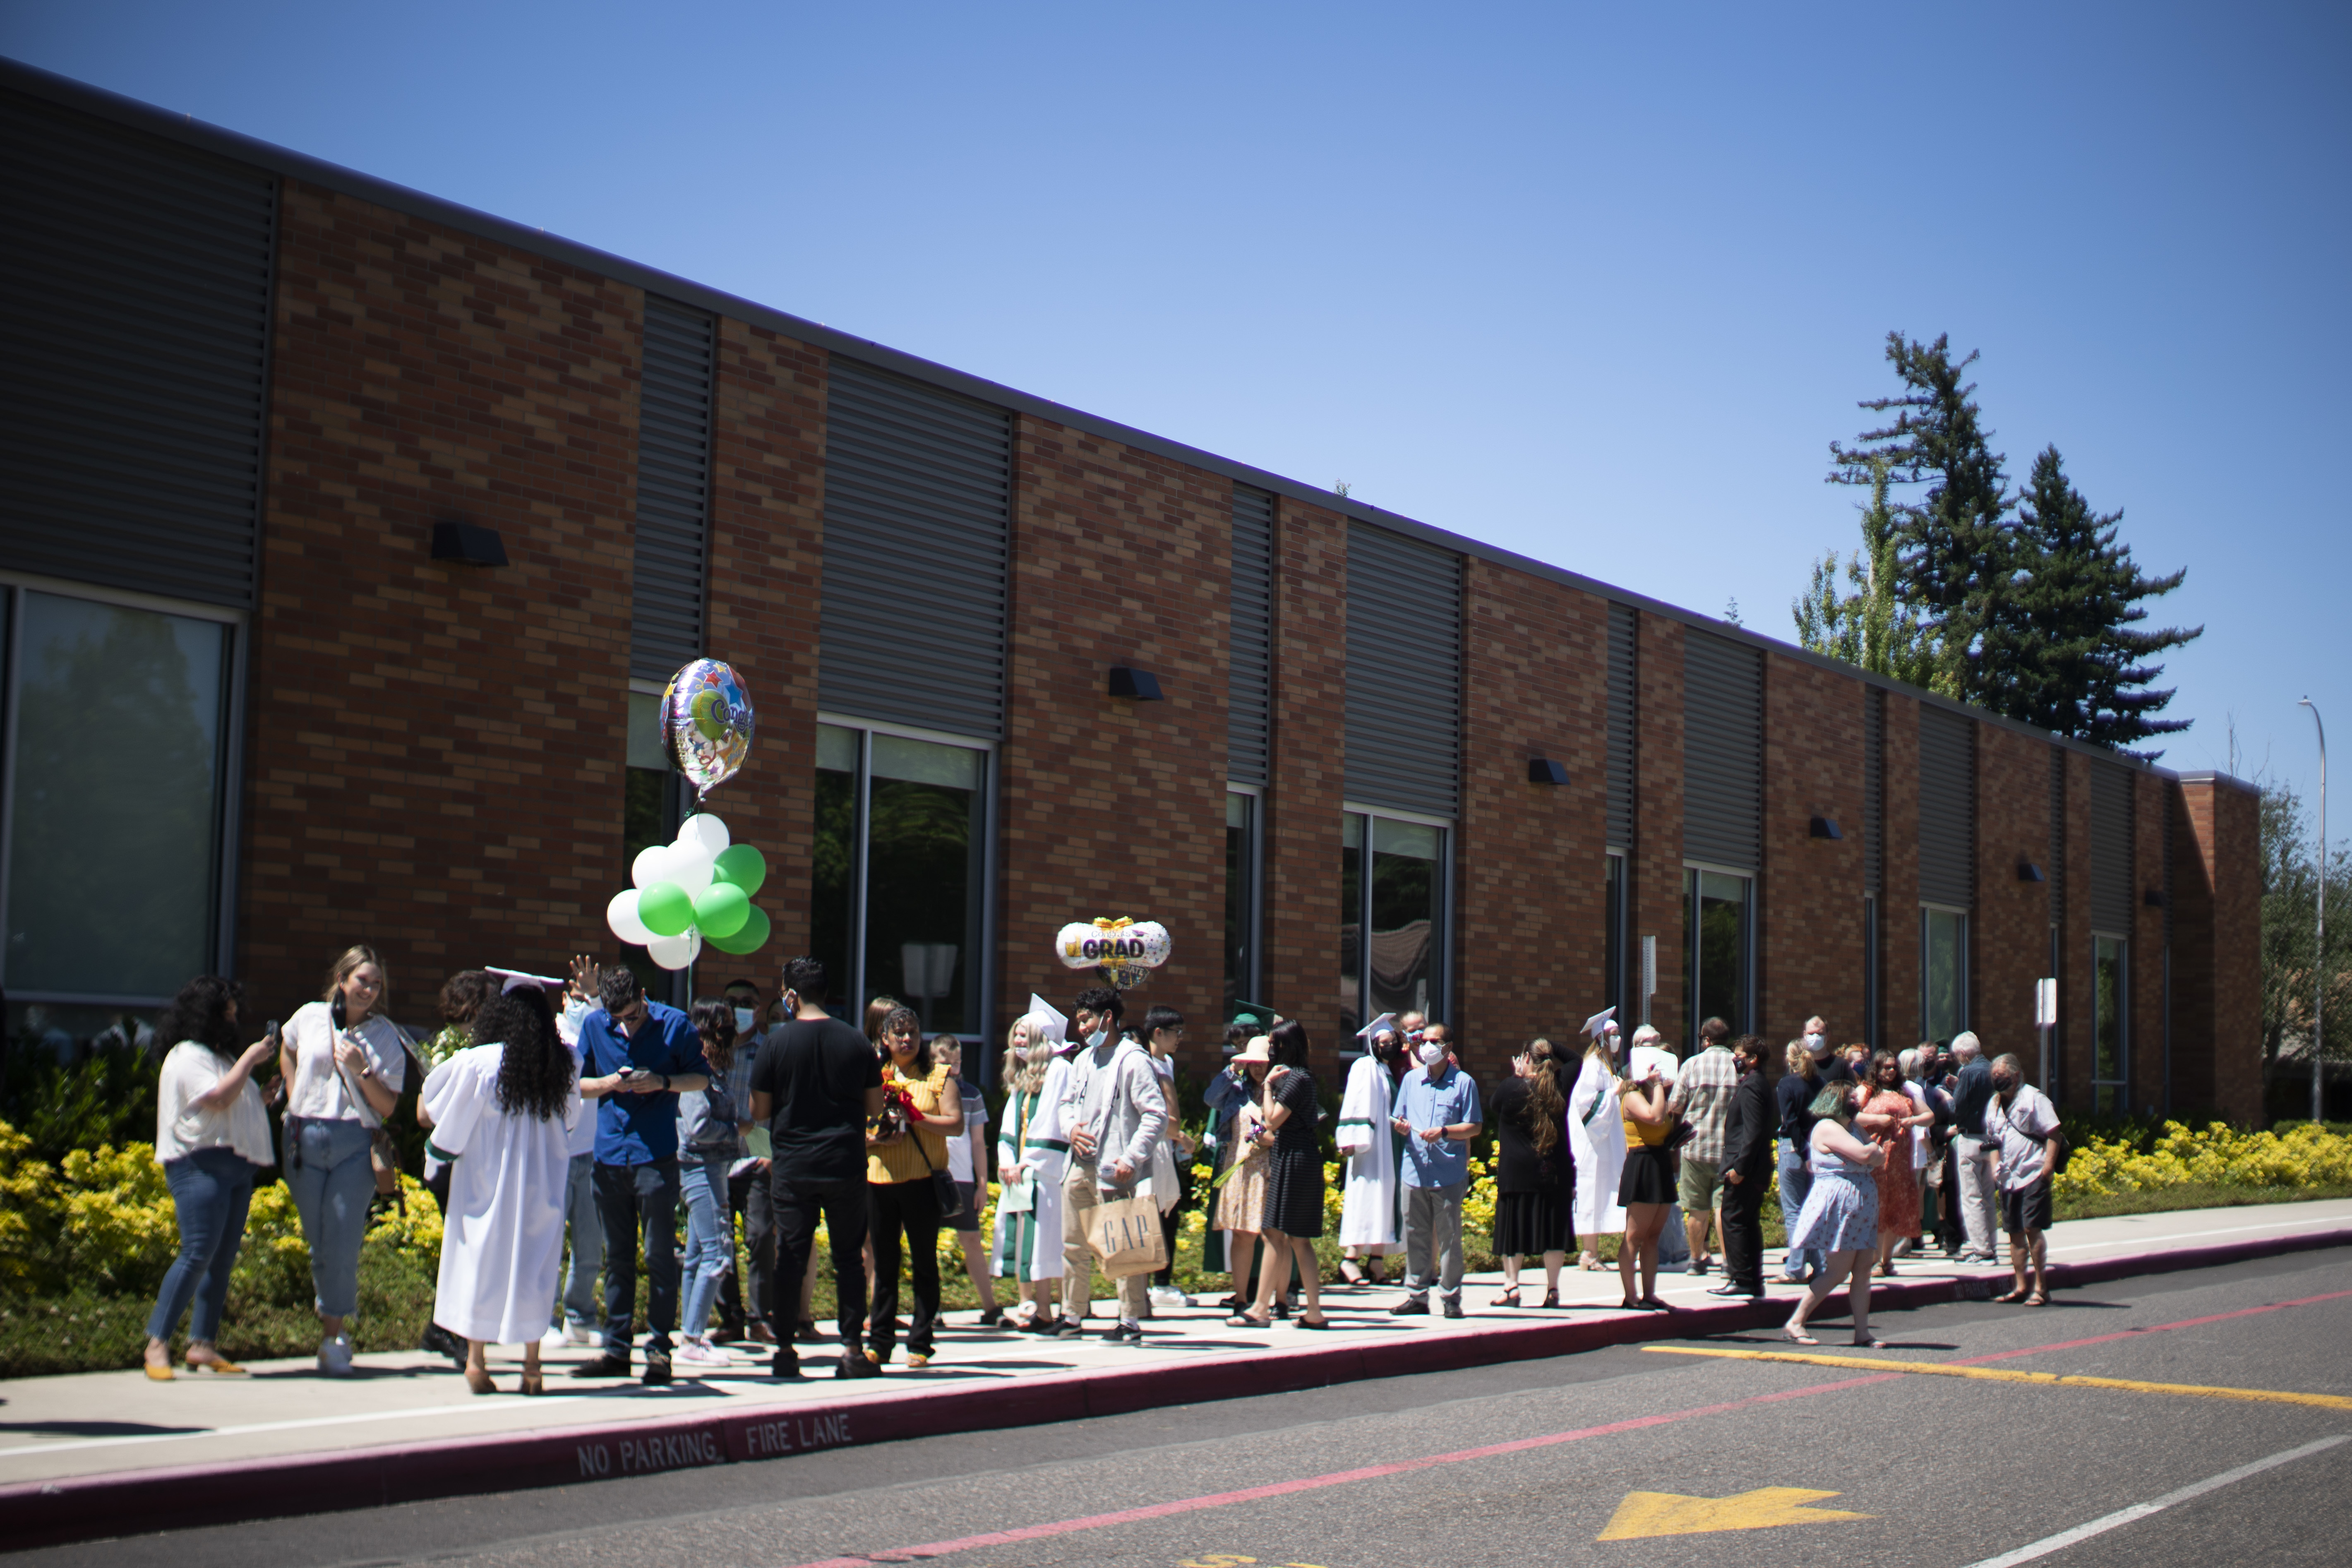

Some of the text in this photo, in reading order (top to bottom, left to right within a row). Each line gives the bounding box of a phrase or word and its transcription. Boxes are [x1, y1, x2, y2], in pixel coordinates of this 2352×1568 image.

[711, 699, 754, 731] Congra
[1091, 930, 1130, 938] Congrats
[1083, 938, 1145, 959] GRAD
[1104, 1215, 1148, 1253] GAP
[1954, 1283, 1965, 1299] NO
[1965, 1281, 1991, 1297] PARKING
[576, 1413, 853, 1477] NO PARKING FIRE LANE
